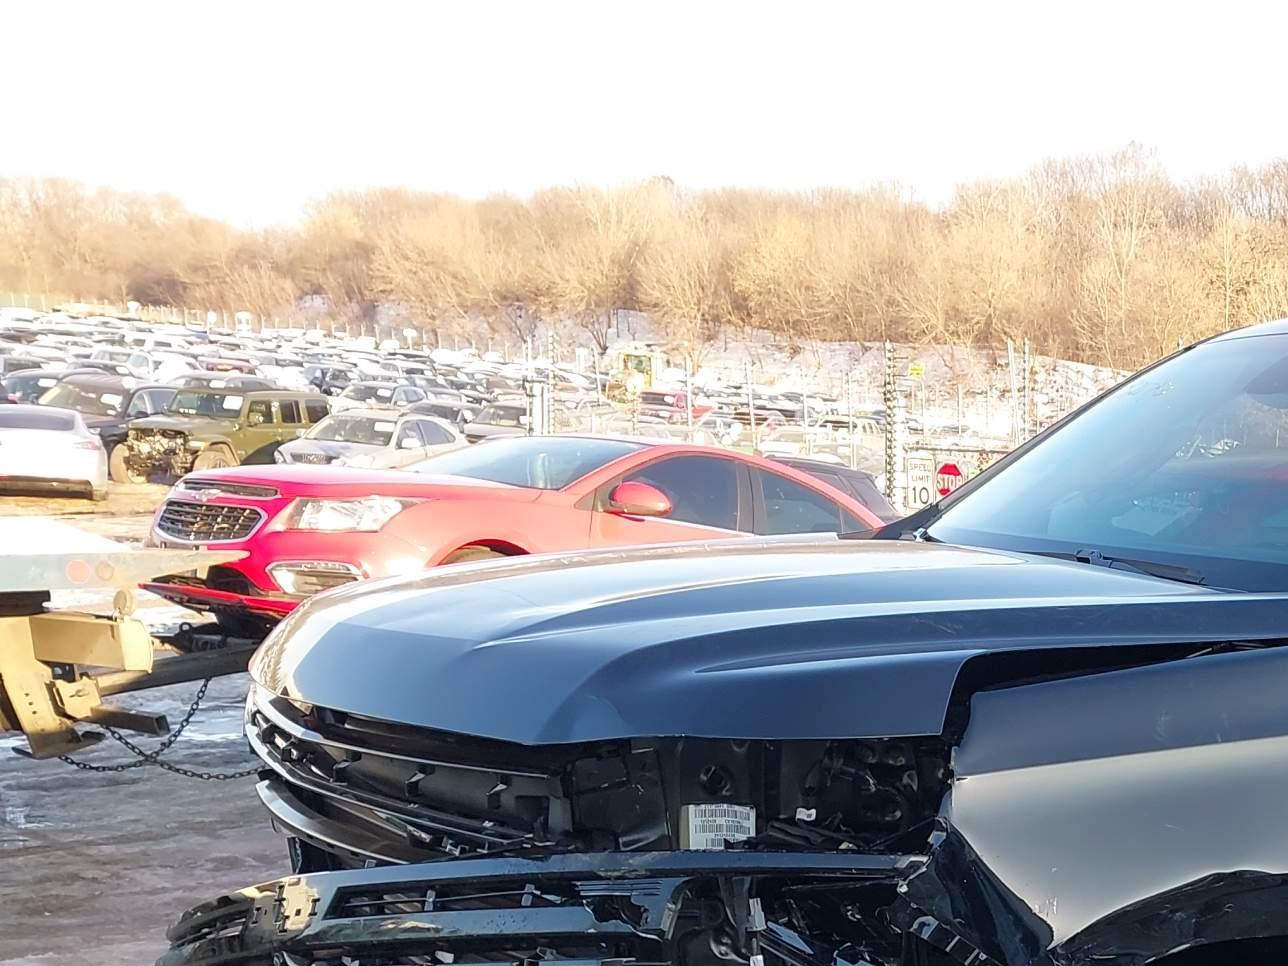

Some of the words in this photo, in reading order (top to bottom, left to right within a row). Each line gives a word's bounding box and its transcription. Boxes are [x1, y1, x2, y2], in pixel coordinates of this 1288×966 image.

[912, 474, 930, 483] LIMIT
[936, 474, 963, 490] STOP
[912, 486, 930, 504] 10
